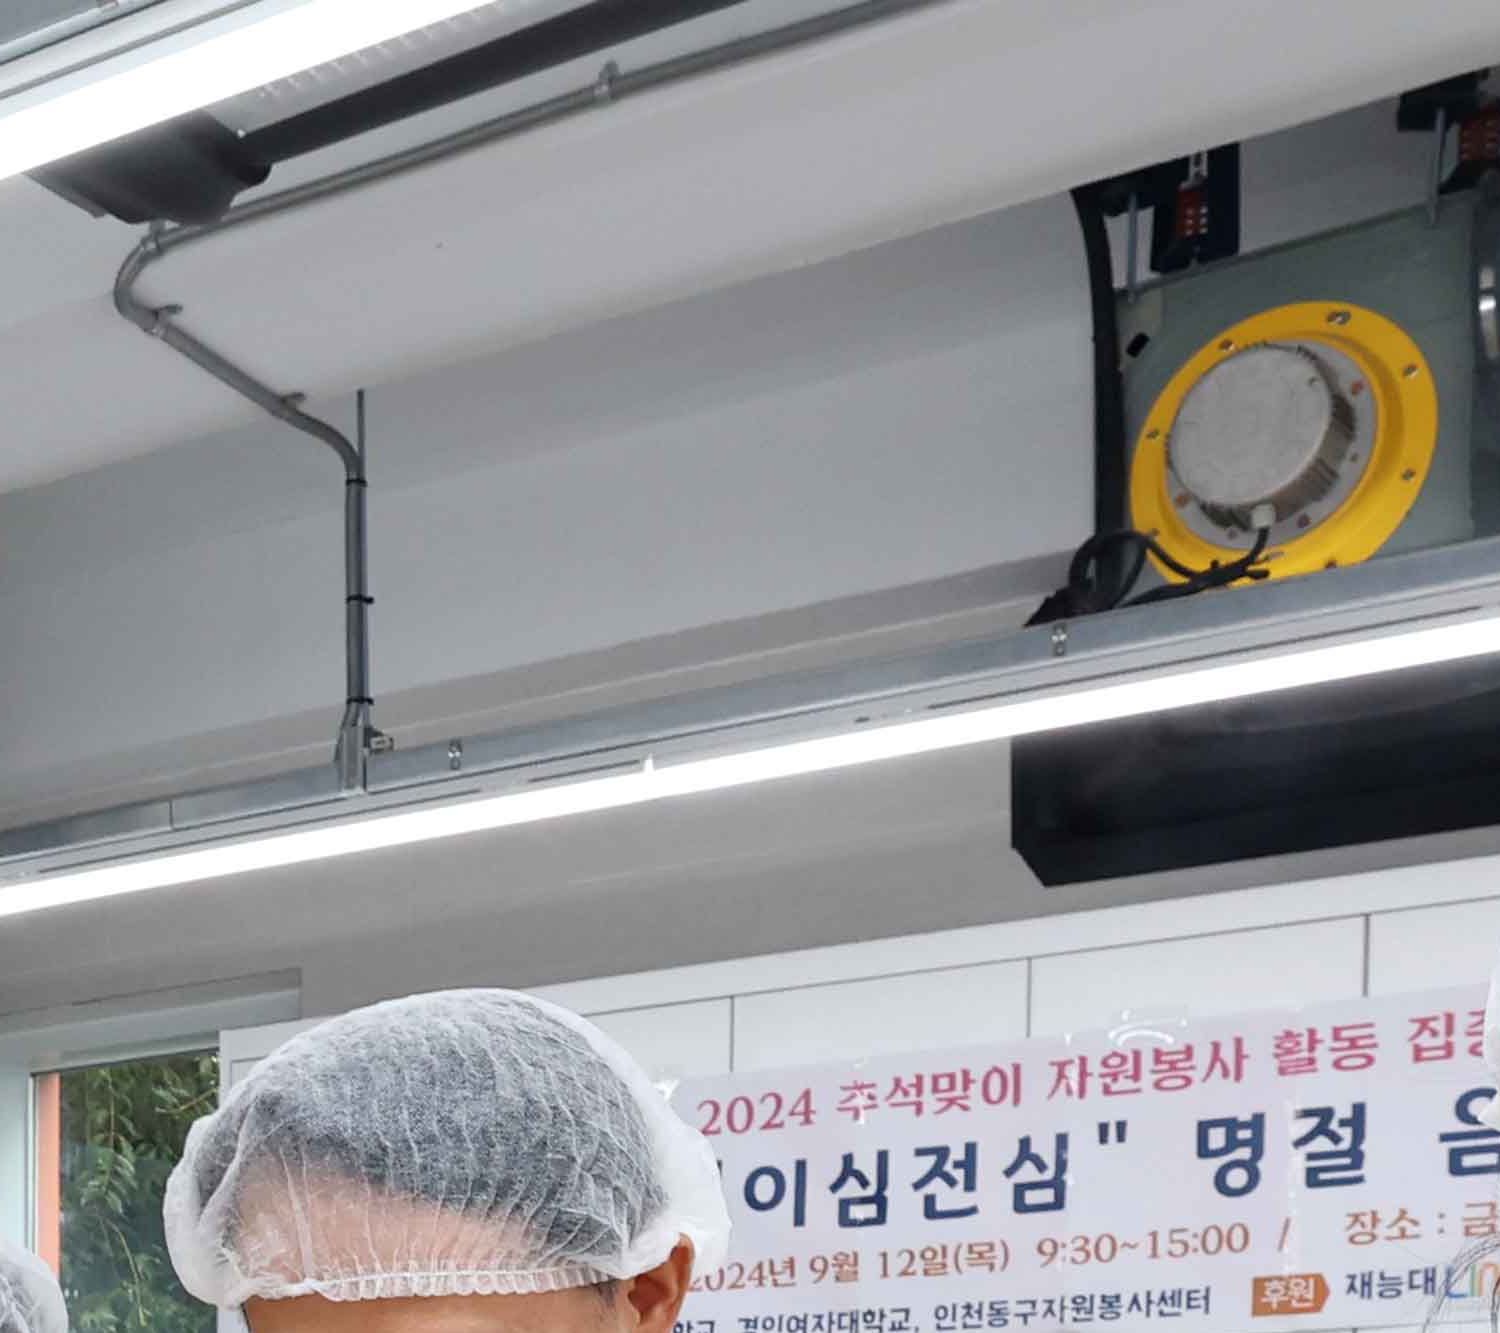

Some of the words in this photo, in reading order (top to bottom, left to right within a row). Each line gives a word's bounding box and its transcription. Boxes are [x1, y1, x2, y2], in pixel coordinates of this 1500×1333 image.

[697, 1089, 816, 1136] 2024
[836, 1062, 1022, 1123] 추석맞이
[1047, 1037, 1250, 1100] 자원봉사
[1272, 1022, 1379, 1076] 활동
[1196, 1102, 1367, 1199] 명절
[809, 1251, 860, 1286] 9월
[877, 1239, 1011, 1281] 12일(목)
[1036, 1221, 1250, 1269] 9:30~15:00
[1345, 1210, 1421, 1246] 장소
[934, 1288, 1211, 1332] 인천동구자원봉사센터
[1258, 1275, 1317, 1311] 후원
[1346, 1267, 1437, 1300] 재능대
